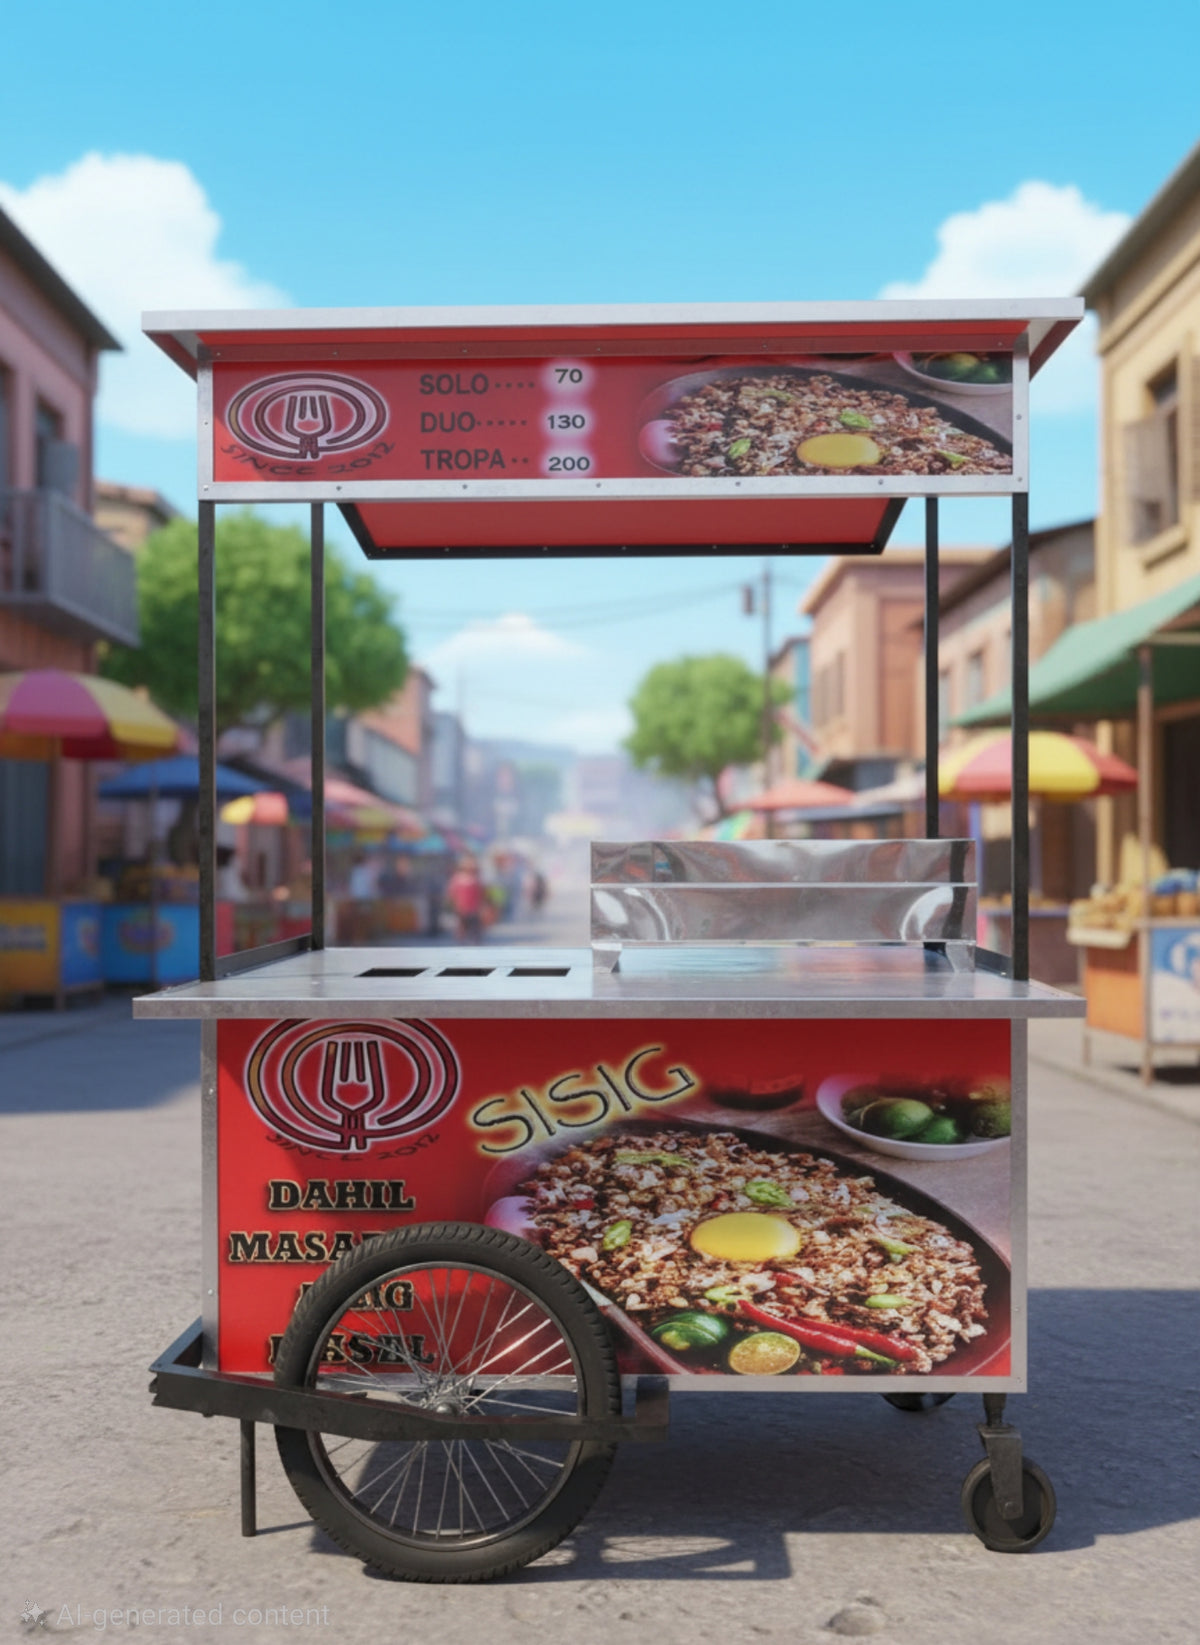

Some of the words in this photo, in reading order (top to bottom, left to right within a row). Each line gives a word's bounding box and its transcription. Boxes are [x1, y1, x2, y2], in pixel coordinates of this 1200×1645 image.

[419, 373, 489, 395] SOLO
[554, 368, 584, 384] 70
[420, 411, 475, 433] DUO
[547, 414, 586, 430] 130
[420, 449, 506, 471] TROPA
[547, 456, 591, 472] 200
[473, 1047, 697, 1154] SISIG
[269, 1179, 416, 1211] DAHIL
[228, 1231, 389, 1263] MASA
